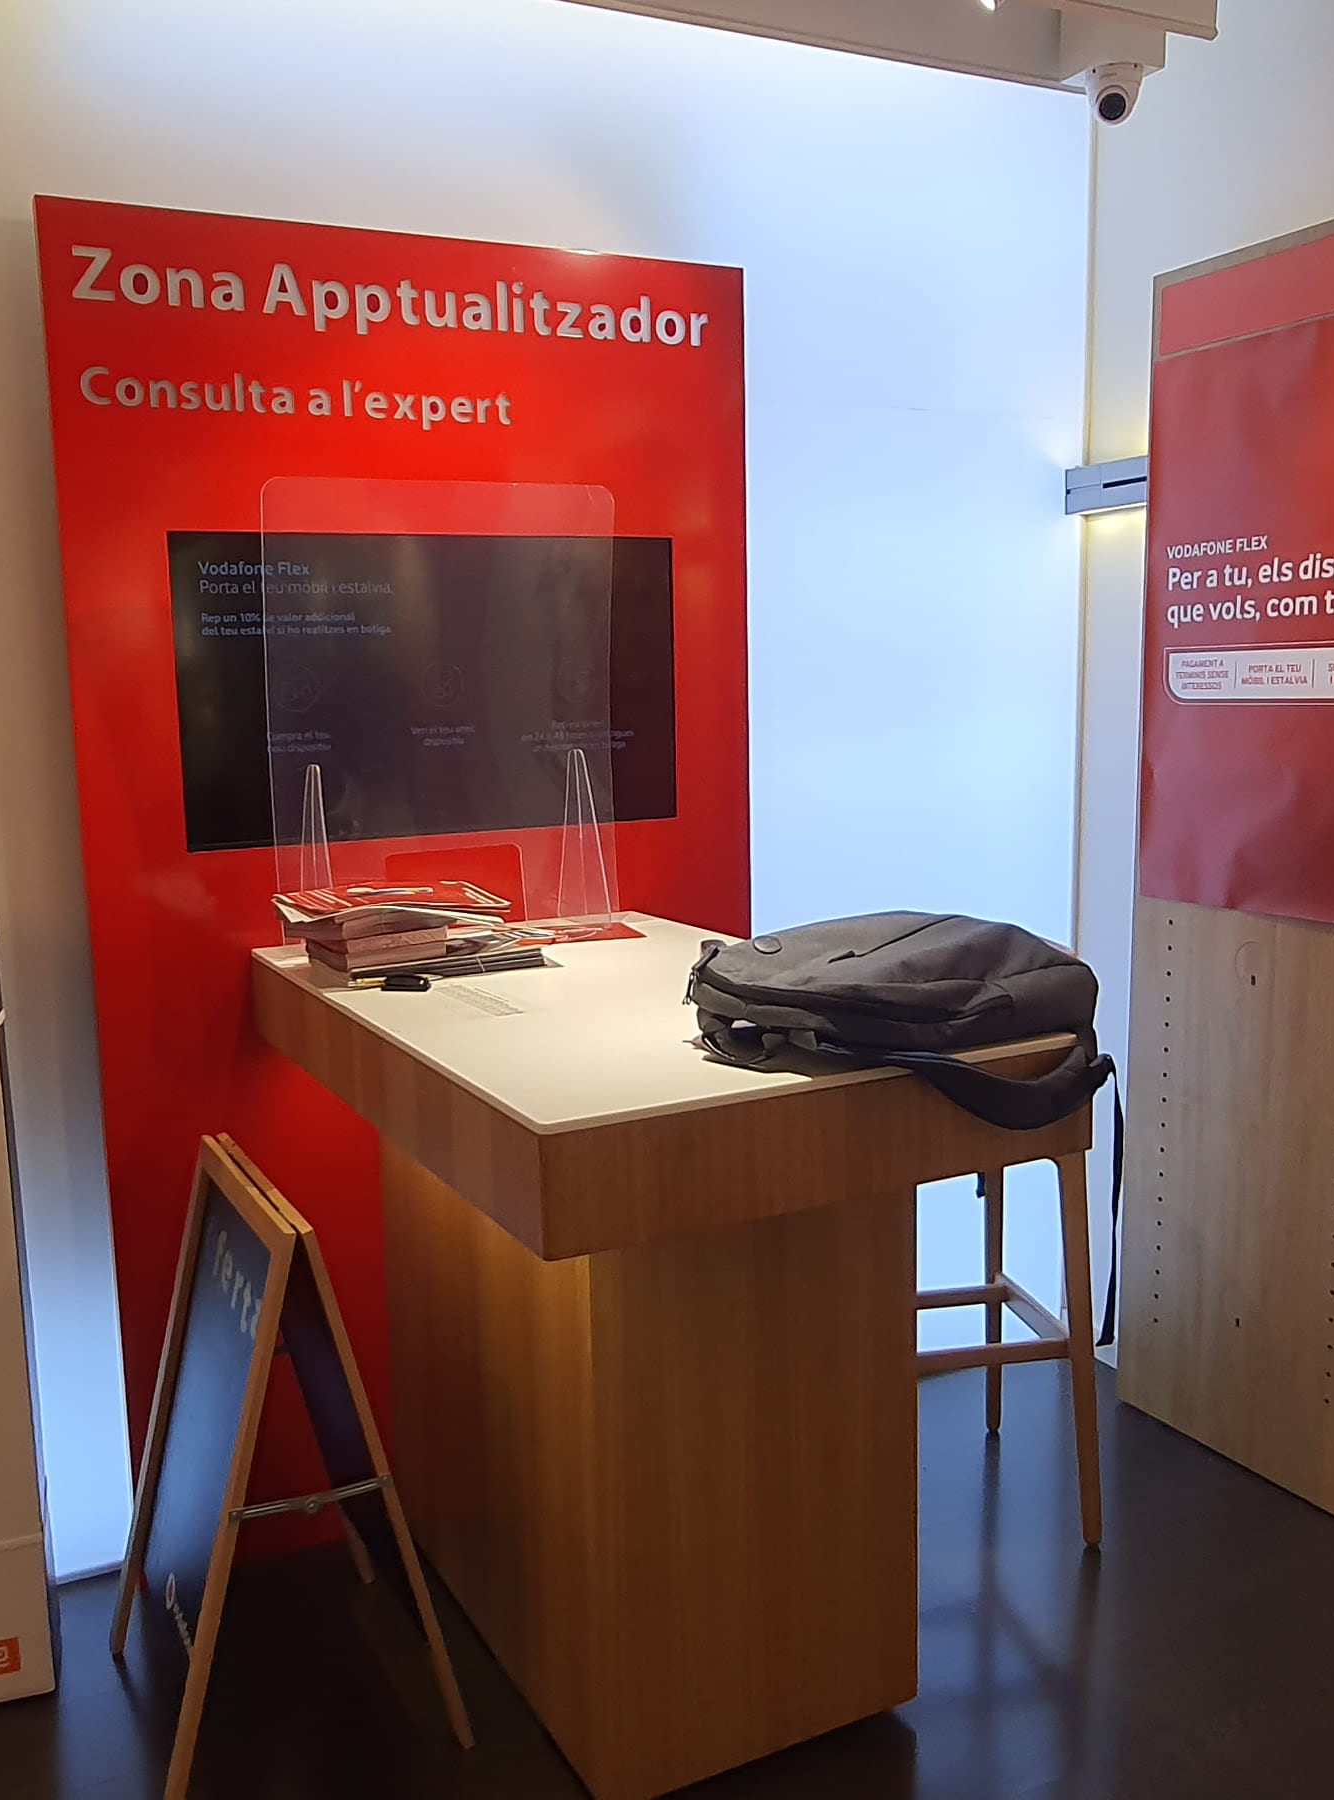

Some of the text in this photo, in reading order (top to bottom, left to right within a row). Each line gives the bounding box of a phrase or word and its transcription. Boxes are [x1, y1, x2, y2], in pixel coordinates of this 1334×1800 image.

[70, 244, 709, 348] Zona Apptualitzador
[79, 365, 512, 430] Consulta a l'expert
[1167, 535, 1268, 559] VODAFONE FLEX
[197, 560, 310, 576] Vodafone Flex
[1167, 566, 1202, 591] Per
[1205, 571, 1218, 588] a
[1223, 563, 1252, 589] tu,
[1258, 557, 1294, 583] els
[199, 580, 239, 594] Porta
[242, 580, 256, 594] el
[201, 613, 221, 625] Rep
[223, 614, 237, 623] un
[239, 612, 261, 623] 10%
[1167, 602, 1204, 629] que
[1208, 594, 1261, 621] vols,
[1266, 595, 1317, 618] com
[202, 625, 219, 636] del
[221, 626, 238, 635] teu
[287, 625, 301, 635] ho
[347, 626, 359, 635] en
[1248, 663, 1302, 673] PORTA EL TEU
[1271, 676, 1308, 684] ESTALVIA
